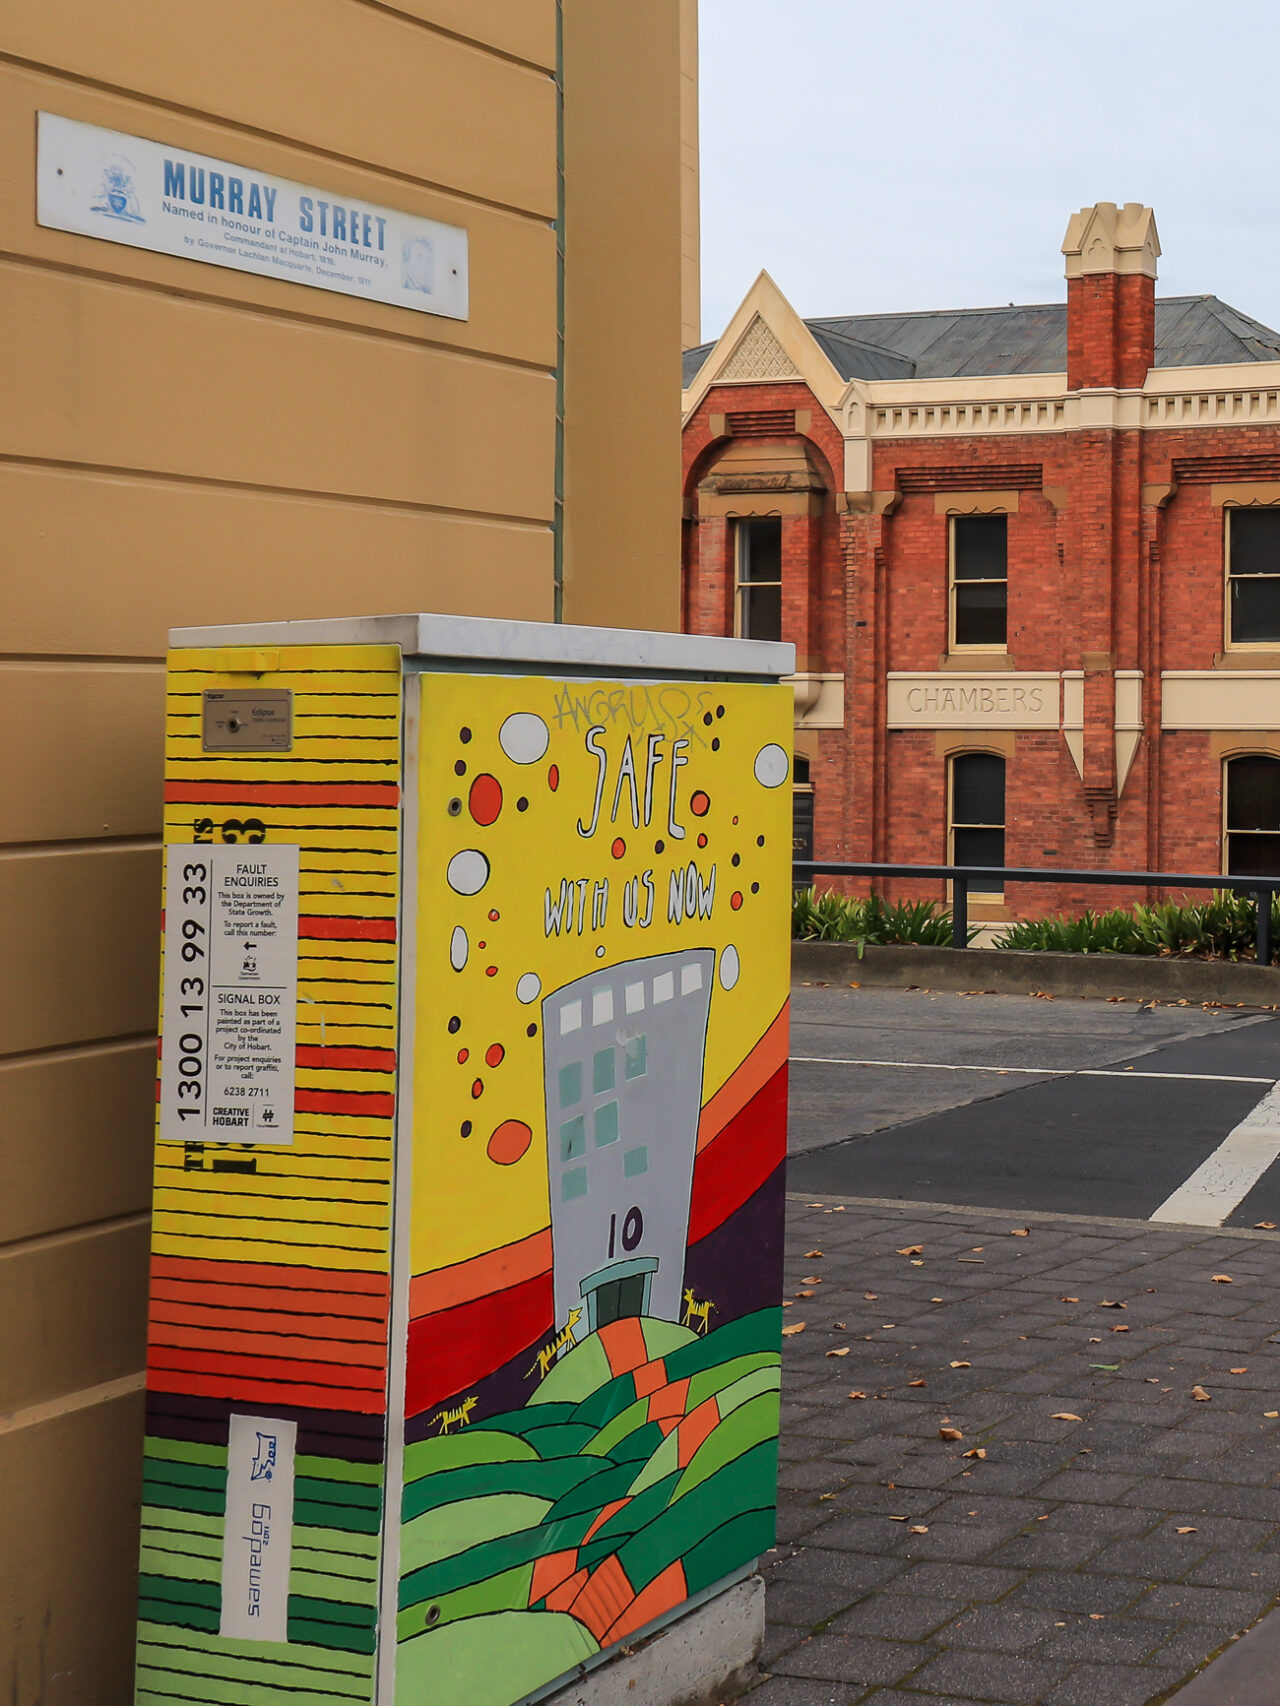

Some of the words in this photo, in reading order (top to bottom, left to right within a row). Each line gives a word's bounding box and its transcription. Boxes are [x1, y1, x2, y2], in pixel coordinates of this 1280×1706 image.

[163, 158, 278, 223] MURRAY
[299, 195, 387, 252] STREET
[162, 201, 204, 221] Named
[207, 211, 218, 224] in
[221, 215, 261, 235] honour
[265, 228, 275, 239] of
[278, 230, 319, 250] Captain
[322, 241, 347, 257] John
[224, 231, 277, 252] Commandant
[197, 238, 236, 254] Governor
[238, 248, 270, 263] Lachlan
[906, 686, 1044, 714] CHAMBERS
[577, 725, 690, 840] SAFE
[236, 864, 267, 875] FAULT
[183, 864, 207, 905] 33
[224, 876, 279, 888] ENQUIRIES
[218, 891, 231, 899] This
[232, 891, 244, 899] box
[253, 892, 275, 900] owned
[276, 892, 285, 903] by
[544, 877, 609, 939] WITH
[623, 869, 655, 929] US
[668, 860, 717, 926] NOW
[234, 900, 272, 909] Department
[228, 908, 245, 916] State
[247, 908, 273, 916] Growth.
[224, 920, 232, 928] To
[233, 921, 253, 931] report
[261, 921, 277, 929] fault,
[236, 929, 248, 937] this
[181, 919, 205, 962] 99
[180, 977, 204, 1018] 13
[217, 993, 255, 1005] SIGNAL
[258, 994, 281, 1005] BOX
[220, 1008, 233, 1016] This
[248, 1009, 260, 1017] has
[217, 1018, 242, 1026] painted
[267, 1018, 275, 1026] of
[215, 1026, 239, 1035] project
[240, 1026, 282, 1035] co-ordinated
[237, 1034, 246, 1043] by
[247, 1034, 259, 1042] the
[223, 1042, 237, 1051] City
[247, 1043, 272, 1051] Hobart.
[214, 1053, 226, 1061] For
[227, 1055, 250, 1064] project
[251, 1056, 282, 1064] enquiries
[233, 1064, 254, 1072] report
[177, 1033, 203, 1121] 1300
[223, 1086, 246, 1097] 6238
[247, 1087, 269, 1097] 2711
[212, 1107, 250, 1117] CREATIVE
[212, 1117, 249, 1127] HOBART
[608, 1206, 644, 1259] 10
[242, 1503, 271, 1617] samedog
